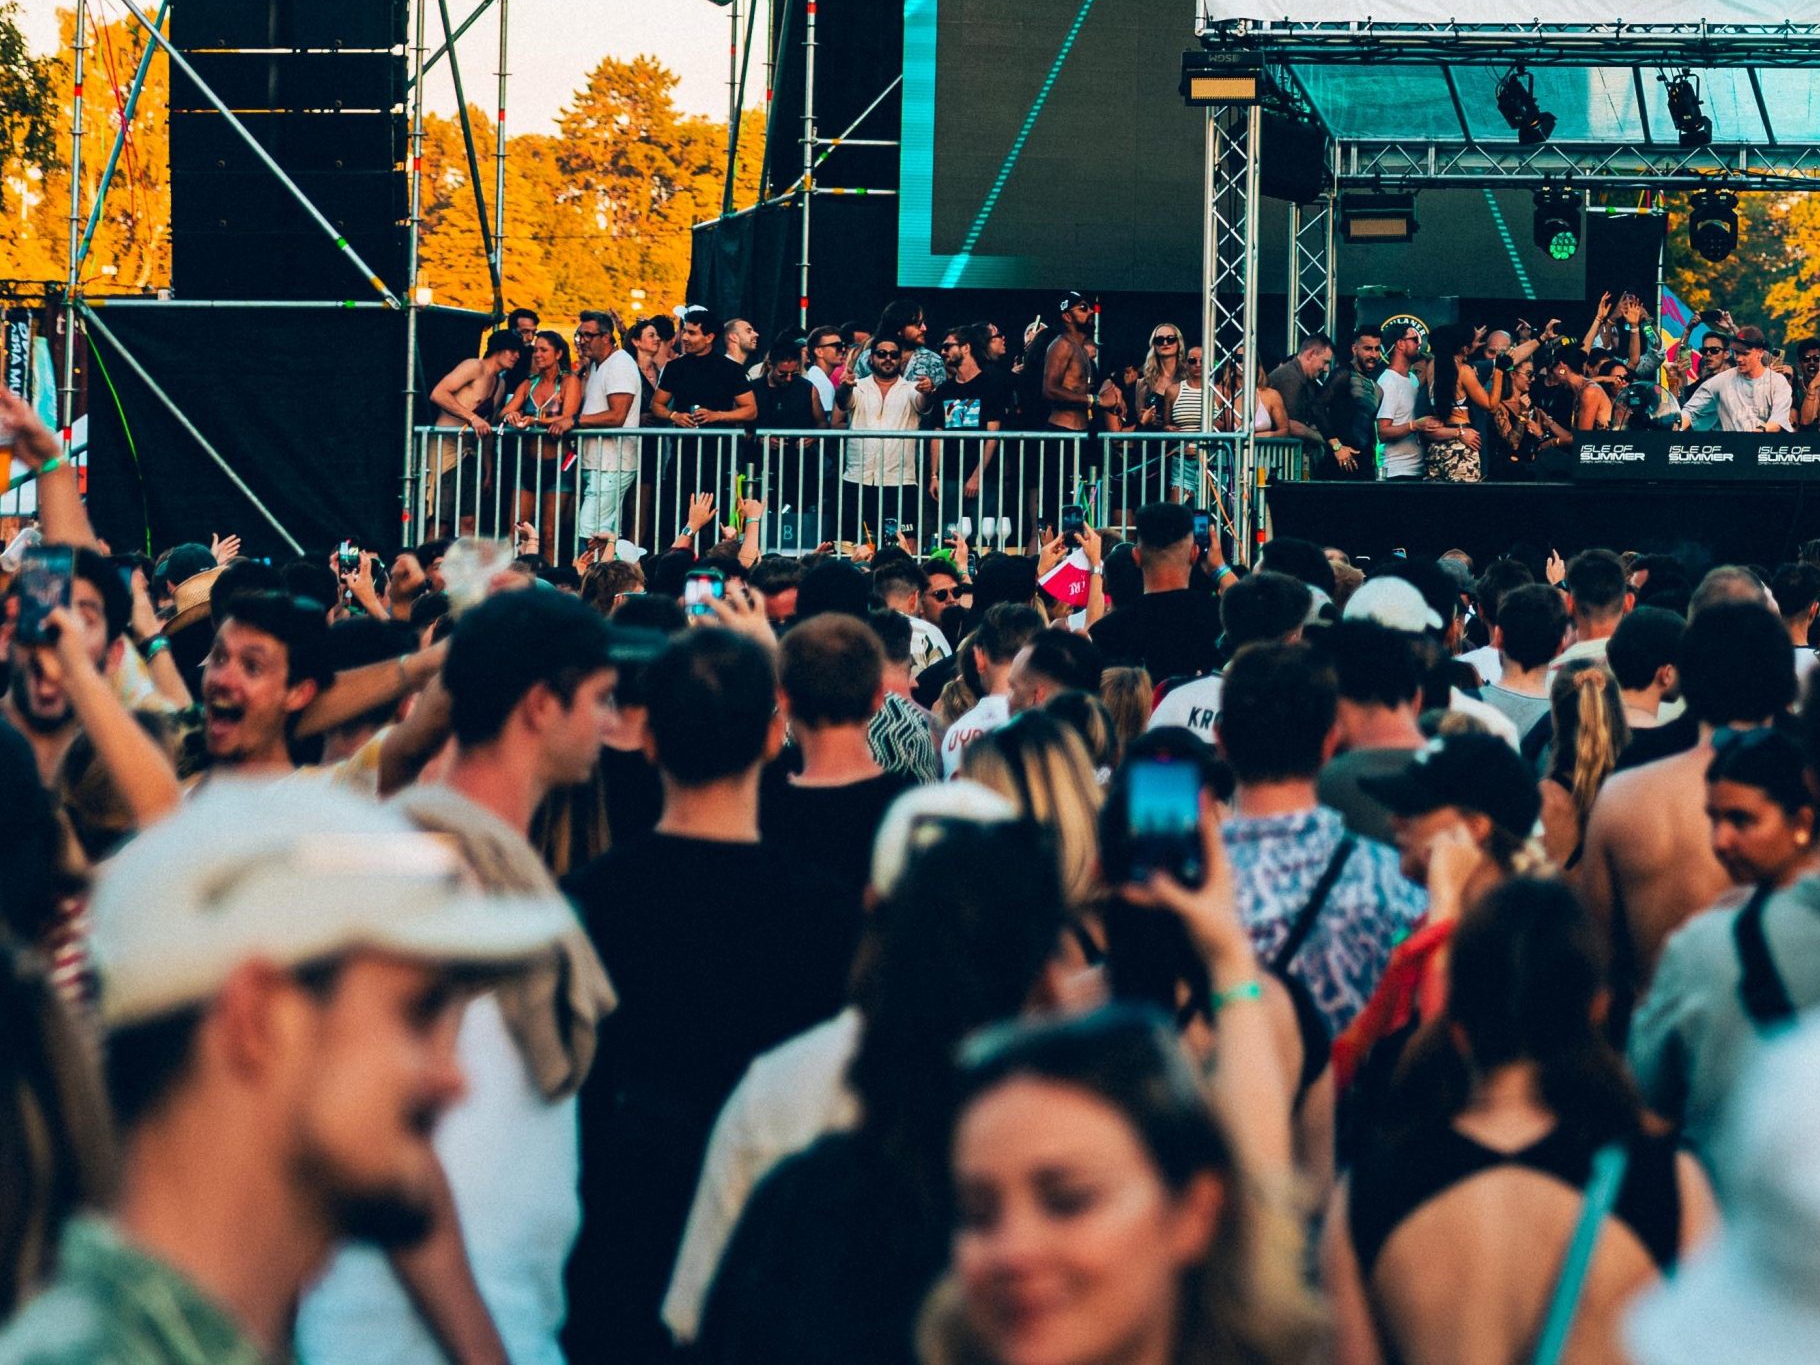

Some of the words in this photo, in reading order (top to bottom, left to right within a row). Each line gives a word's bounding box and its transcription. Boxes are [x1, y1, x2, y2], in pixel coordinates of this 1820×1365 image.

[1613, 445, 1633, 453] OF
[1702, 446, 1722, 454] OF
[1791, 447, 1811, 455] OF
[1580, 453, 1645, 461] SUMMER
[1669, 454, 1733, 462] SUMMER
